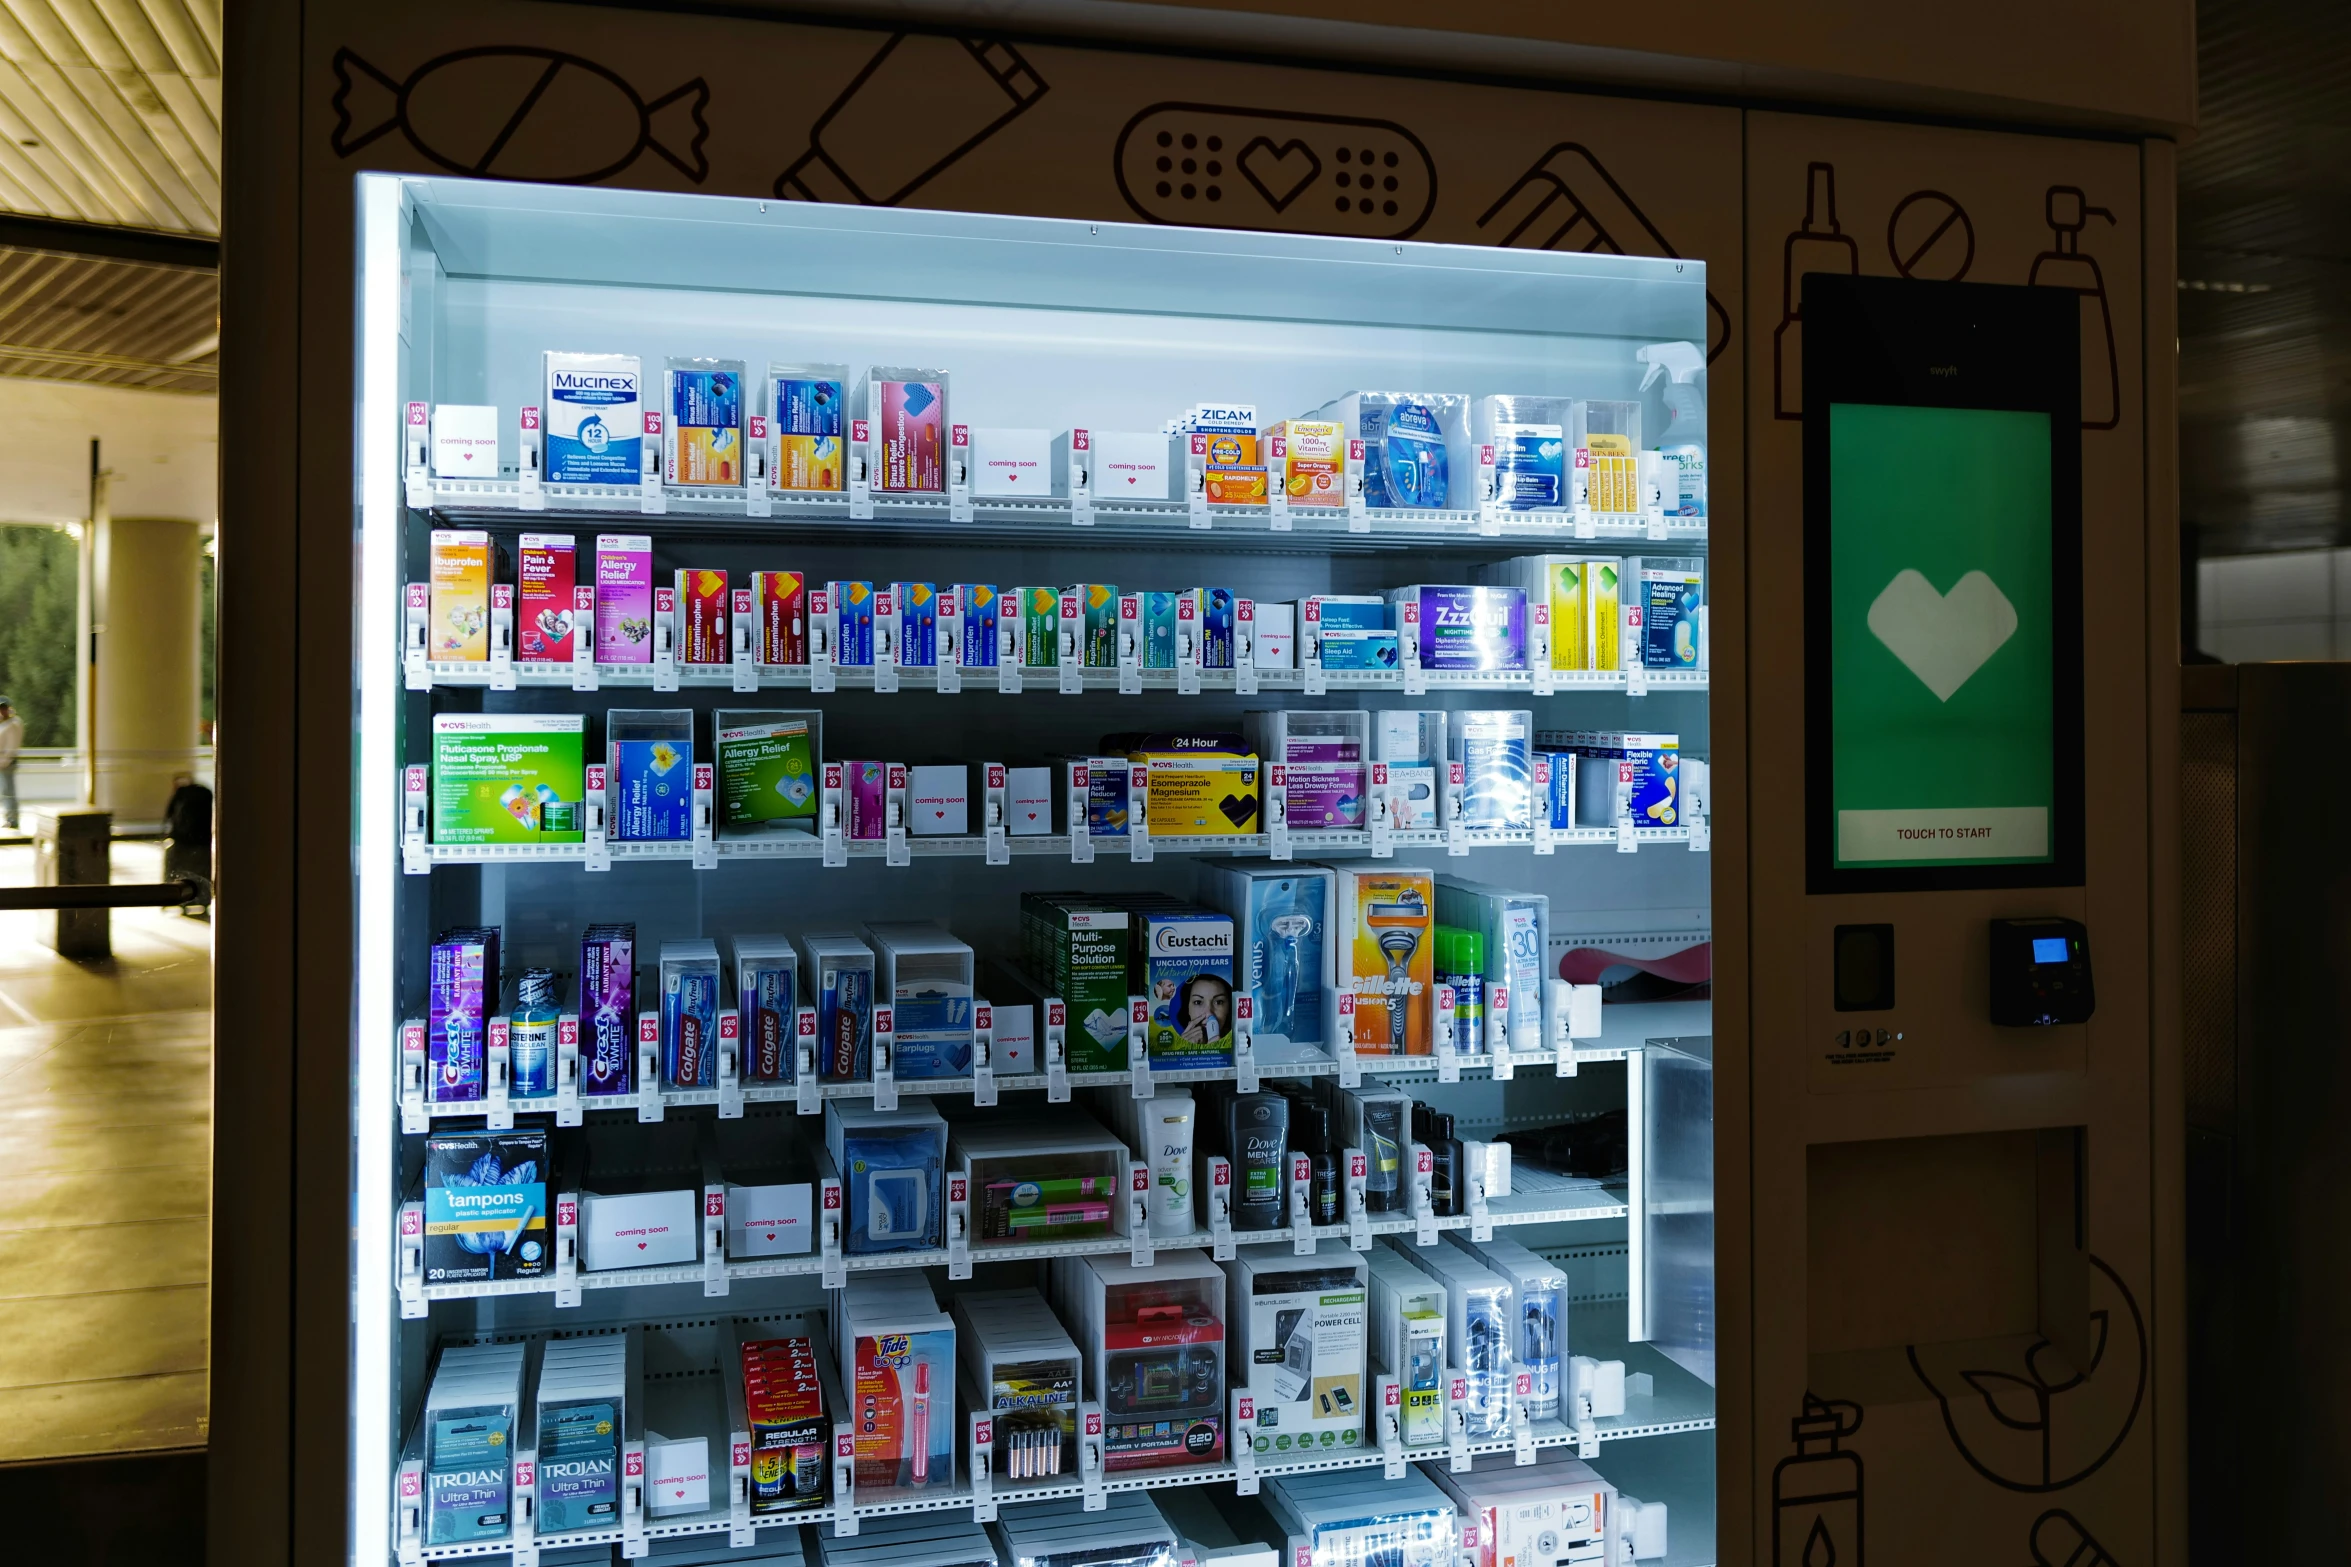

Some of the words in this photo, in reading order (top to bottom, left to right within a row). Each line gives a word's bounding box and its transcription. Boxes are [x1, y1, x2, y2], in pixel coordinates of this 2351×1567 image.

[1930, 364, 1958, 378] swyft
[556, 374, 634, 390] Mucinex
[688, 386, 696, 404] Relief
[411, 406, 425, 414] 101
[688, 405, 696, 425] Sinus
[1202, 410, 1252, 421] ZICAM
[1400, 412, 1426, 425] abreva
[587, 429, 602, 438] 12
[897, 410, 906, 454] Congestion
[1076, 432, 1088, 440] 107
[890, 439, 898, 460] Relief
[890, 462, 898, 488] Sinus
[897, 456, 906, 488] Severe
[435, 556, 482, 568] Ibuprofen
[524, 556, 545, 565] Pain
[547, 556, 555, 565] &
[601, 560, 636, 572] Allergy
[524, 564, 551, 573] Fever
[601, 570, 629, 580] Relief
[1652, 584, 1683, 592] Advanced
[1652, 590, 1676, 599] Healing
[692, 598, 702, 661] Acetaminophen
[771, 600, 780, 662] Acetaminophen
[842, 624, 850, 664] Ibuprofen
[905, 625, 913, 664] Ibuprofen
[966, 626, 974, 665] Ibuprofen
[1324, 648, 1340, 656] Sleep
[730, 729, 766, 738] CVSHealth
[1176, 738, 1189, 747] 24
[1192, 738, 1218, 747] Hour
[440, 745, 495, 753] Fluticasone
[497, 745, 548, 754] Propionate
[724, 746, 759, 759] Allergy
[761, 743, 790, 754] Relief
[1627, 750, 1653, 758] Flexible
[440, 754, 467, 763] Nasal
[469, 754, 499, 764] Spray,
[501, 754, 522, 762] USP
[409, 772, 423, 780] 301
[1560, 757, 1568, 807] Anti-Diarrheal
[1151, 779, 1211, 788] Esomeprazole
[632, 780, 640, 802] Relief
[1151, 788, 1200, 797] Magnesium
[915, 797, 944, 805] coming
[632, 804, 642, 836] Allergy
[1897, 828, 1936, 840] TOUCH
[1939, 828, 1953, 840] TO
[1956, 827, 1992, 839] START
[1072, 932, 1102, 942] Multi-
[1168, 934, 1228, 948] Eustachi
[1072, 943, 1116, 954] Purpose
[1513, 930, 1538, 958] 30
[1072, 954, 1115, 964] Solution
[1211, 958, 1229, 966] EARS
[1253, 940, 1264, 990] venus
[1352, 975, 1423, 996] Gillette
[1446, 975, 1481, 986] Gillette
[594, 1015, 609, 1081] Crest
[609, 1026, 621, 1071] 3DWHITE
[681, 1021, 696, 1082] Colgate
[762, 1016, 776, 1075] Colgate
[838, 1016, 851, 1075] Colgate
[896, 1044, 935, 1054] Earplugs
[446, 1020, 461, 1085] Crest
[461, 1031, 471, 1076] 3DWHITE
[439, 1142, 478, 1150] CVSHealth
[1248, 1136, 1277, 1150] Dove
[1164, 1145, 1187, 1156] Dove
[449, 1193, 524, 1208] tampons
[482, 1208, 516, 1216] applicator
[430, 1224, 460, 1233] regular
[745, 1219, 775, 1228] coming
[615, 1228, 646, 1237] coming
[429, 1269, 444, 1279] 20
[1324, 1296, 1361, 1304] RECHARGEABLE
[1344, 1318, 1361, 1326] CELL
[880, 1336, 907, 1356] Tide
[874, 1356, 889, 1367] to
[890, 1356, 911, 1369] go
[998, 1391, 1067, 1408] ALKALINE
[766, 1428, 816, 1440] REGULAR
[1188, 1432, 1212, 1443] 220
[766, 1436, 817, 1446] STRENGTH
[1141, 1440, 1178, 1448] PORTABLE
[543, 1459, 612, 1478] TROJAN
[432, 1470, 503, 1488] TROJAN
[552, 1480, 579, 1492] Ultra
[583, 1478, 605, 1488] Thin
[653, 1477, 684, 1486] coming
[441, 1492, 471, 1503] Ultra
[476, 1489, 496, 1500] Thin
